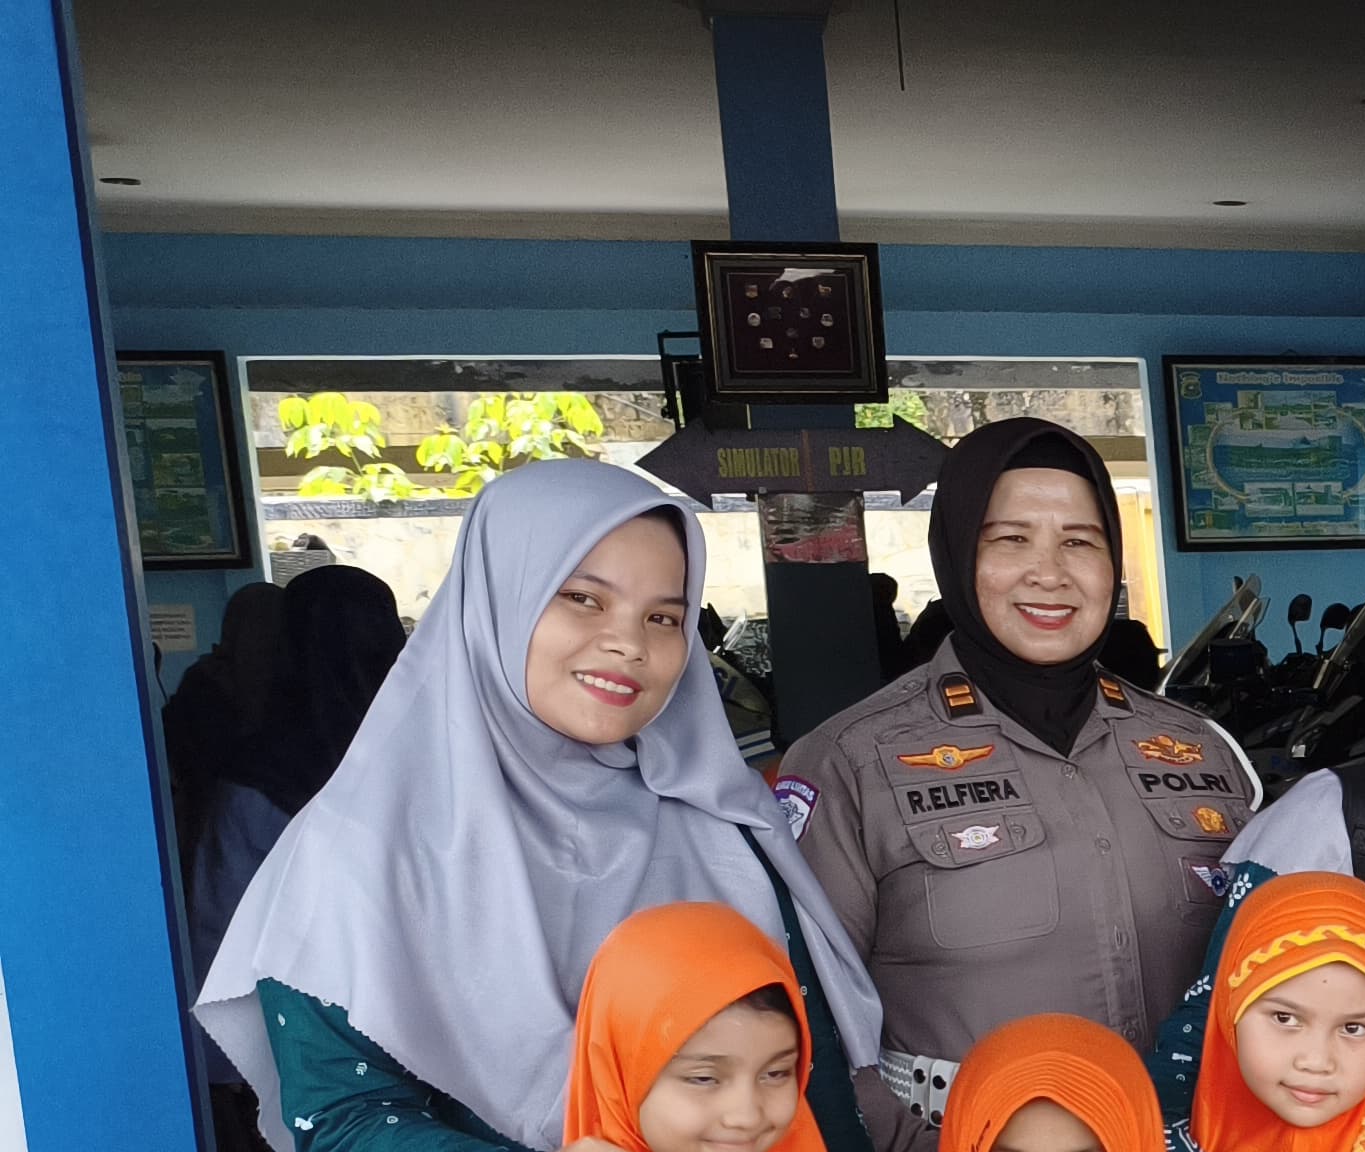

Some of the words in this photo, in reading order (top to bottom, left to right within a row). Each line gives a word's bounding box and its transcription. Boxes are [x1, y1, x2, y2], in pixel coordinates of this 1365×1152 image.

[717, 447, 800, 478] SIMULATOR
[829, 446, 866, 476] PJR
[906, 778, 1020, 815] R.ELFIERA
[1140, 773, 1234, 793] POLRI
